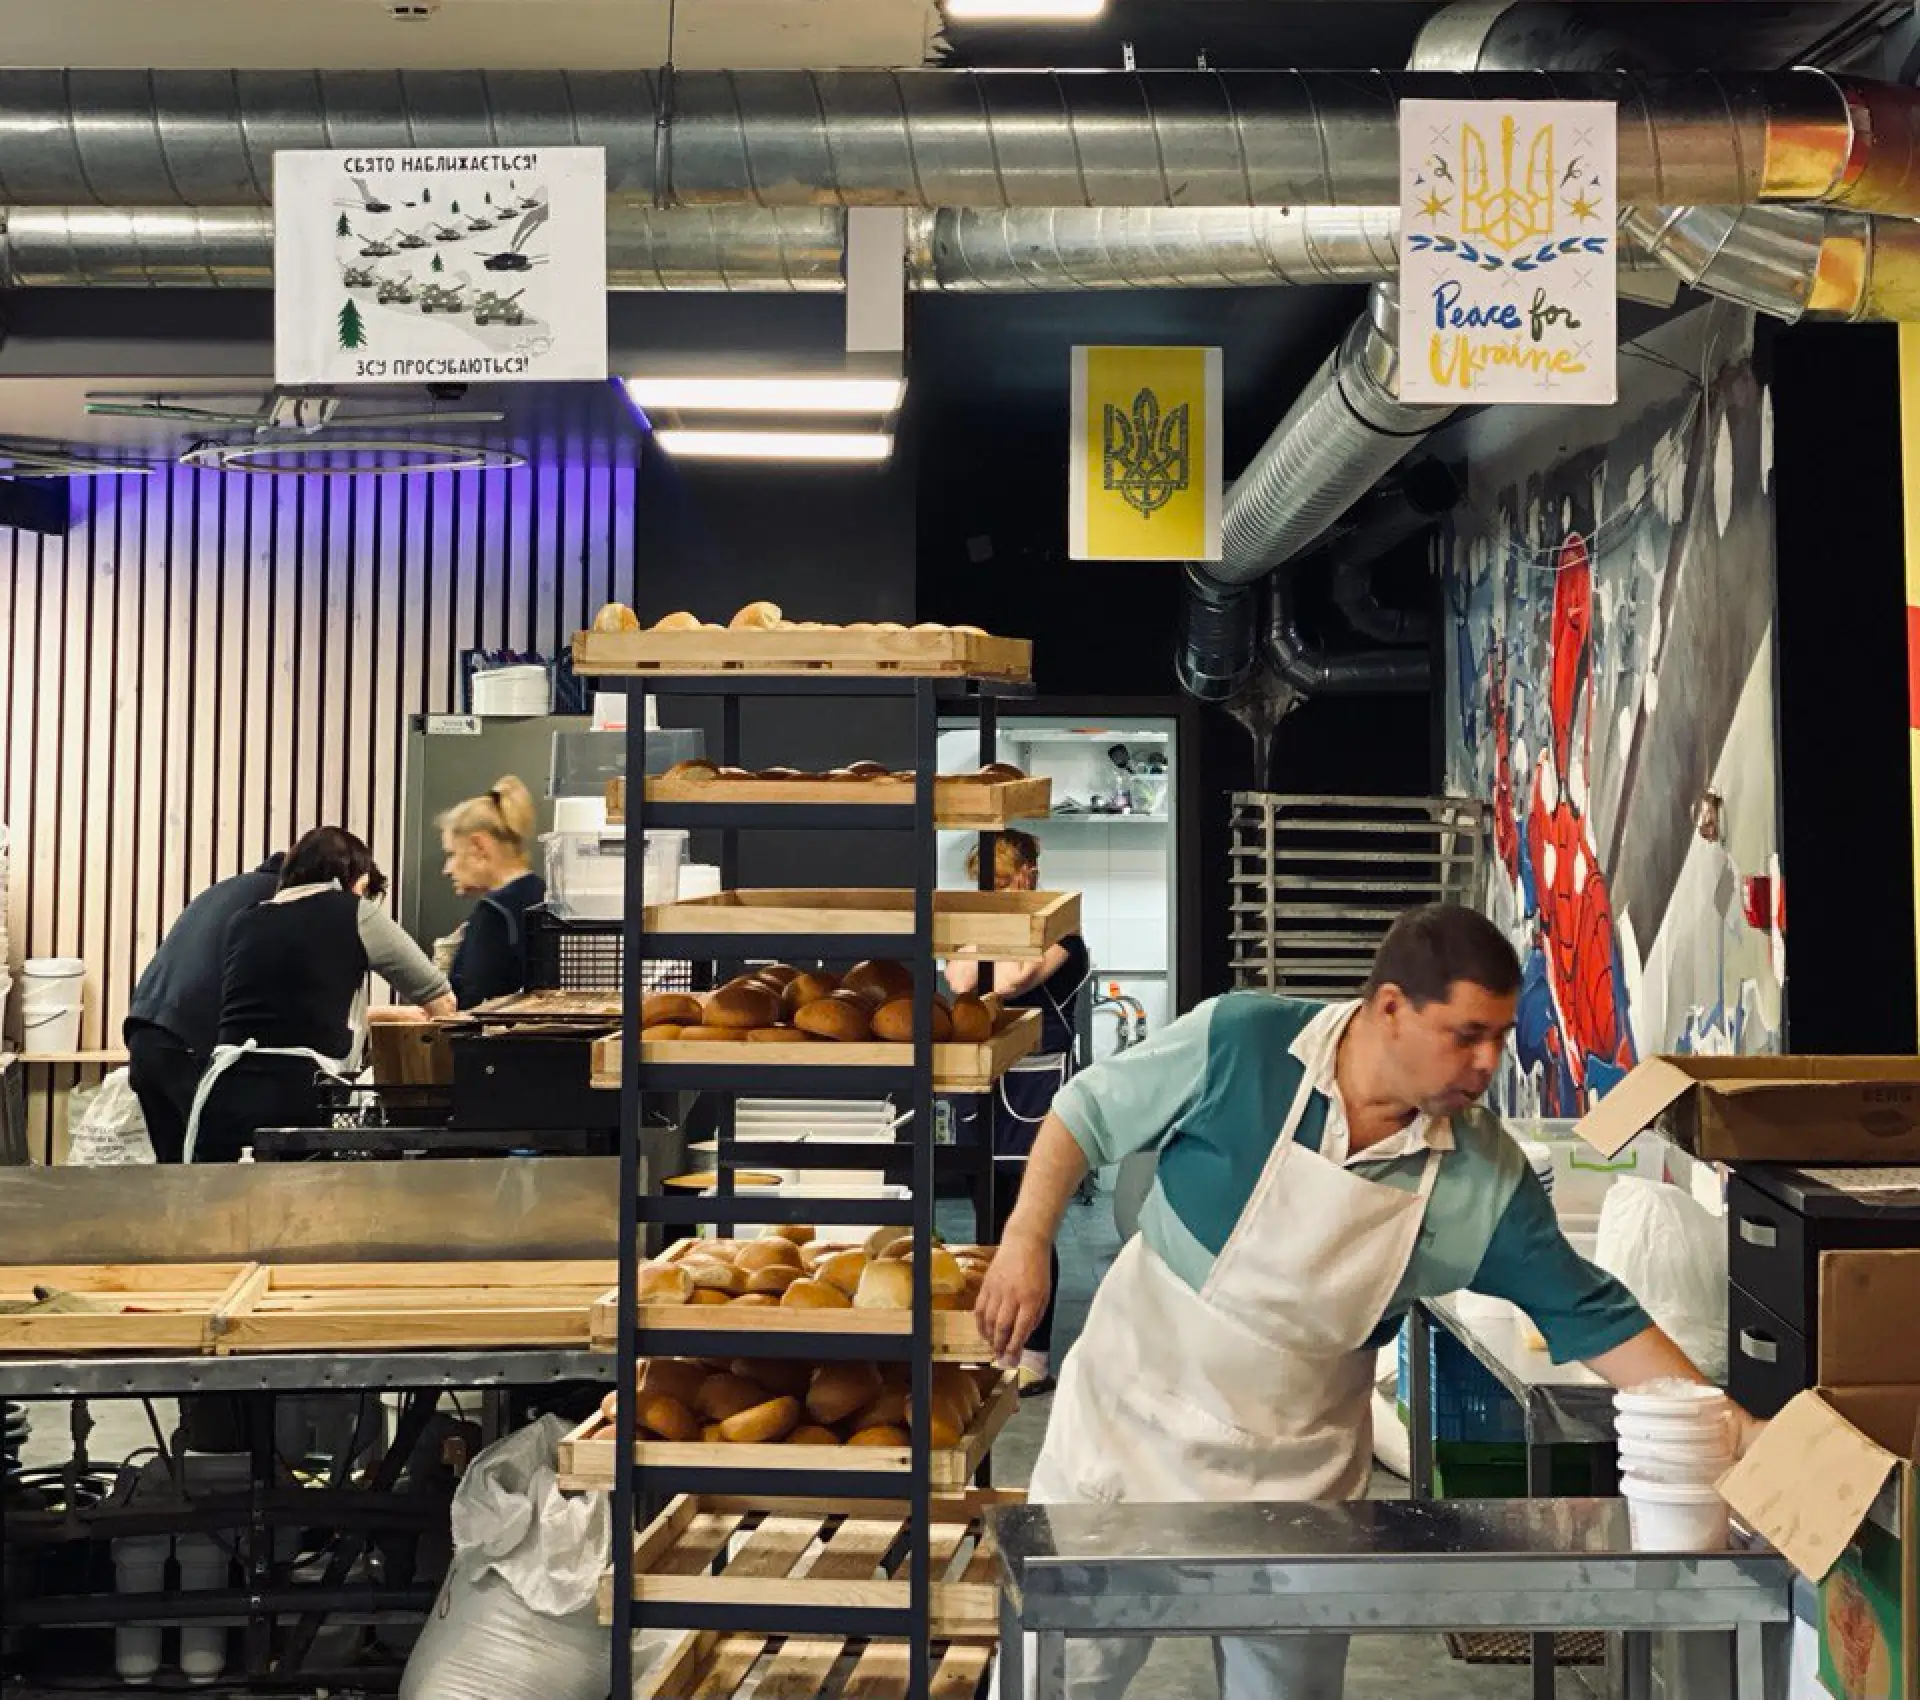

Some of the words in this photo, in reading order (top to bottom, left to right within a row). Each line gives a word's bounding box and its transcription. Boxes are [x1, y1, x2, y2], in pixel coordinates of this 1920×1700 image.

[1433, 280, 1523, 330] Peace
[1528, 287, 1581, 342] for
[355, 360, 387, 376] ЗСУ
[1430, 333, 1586, 389] Ukraine
